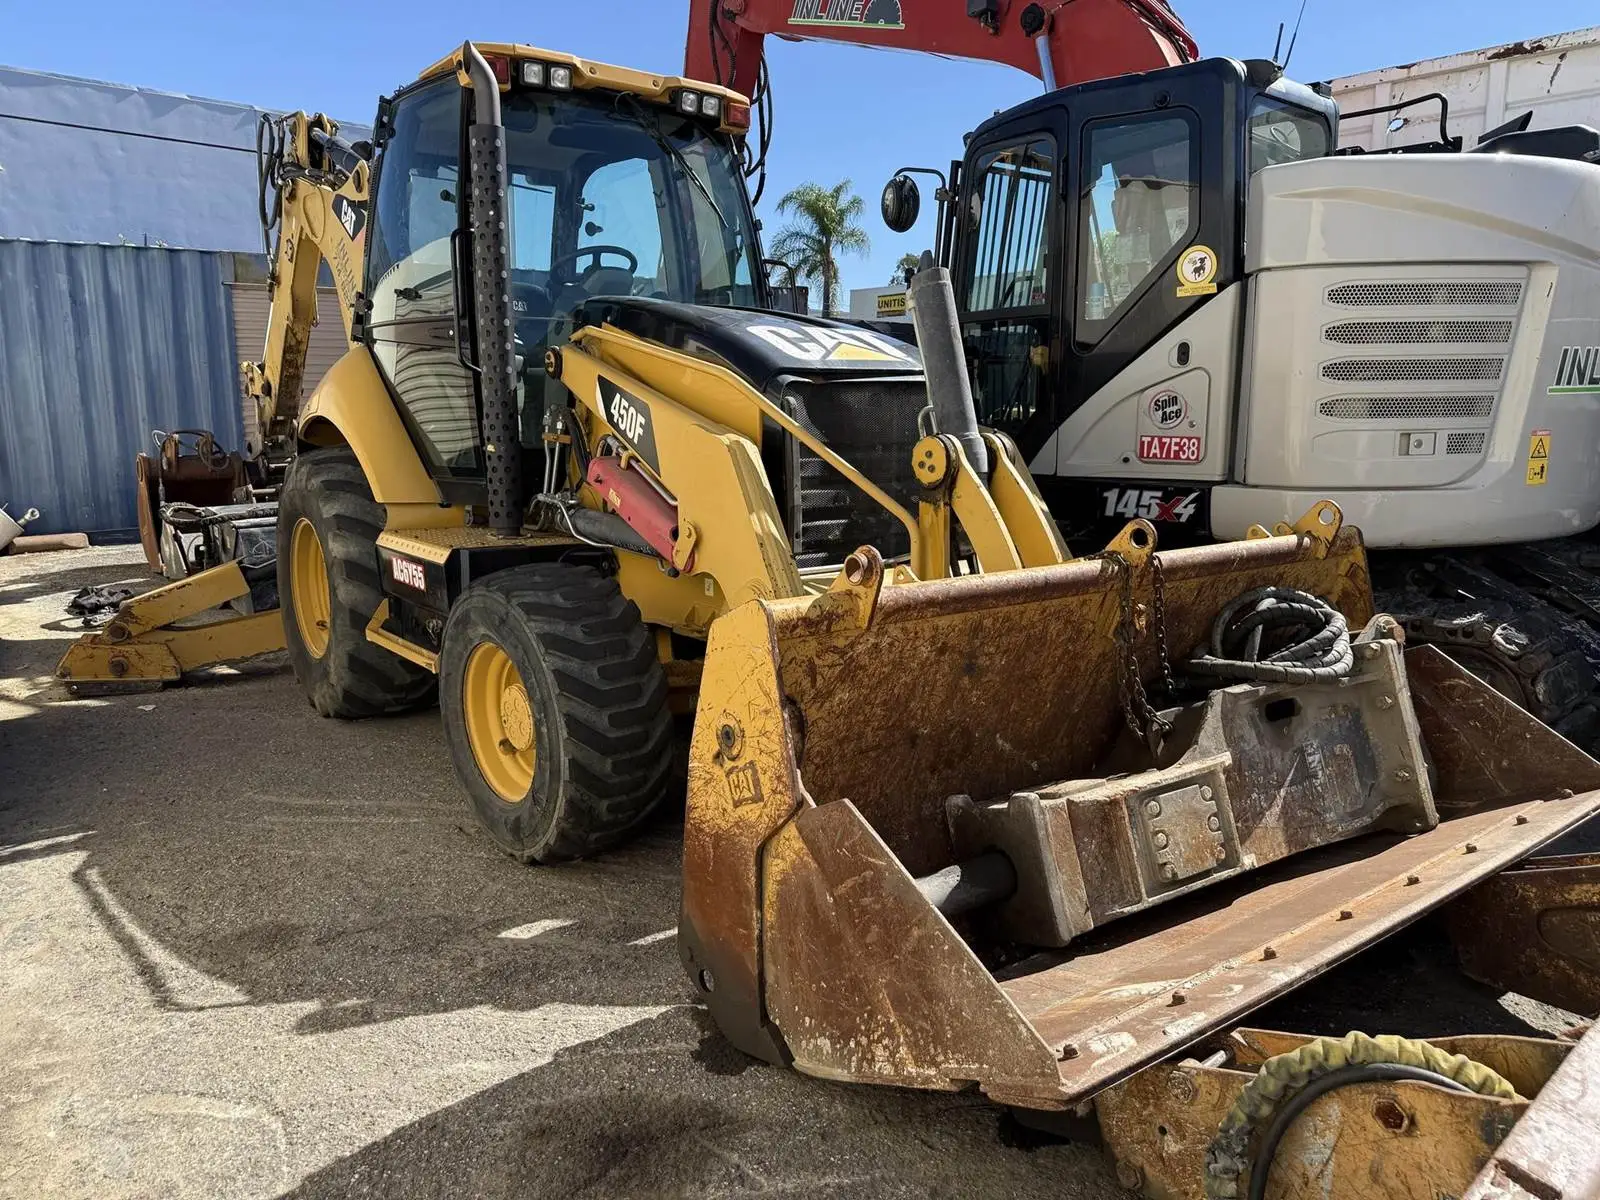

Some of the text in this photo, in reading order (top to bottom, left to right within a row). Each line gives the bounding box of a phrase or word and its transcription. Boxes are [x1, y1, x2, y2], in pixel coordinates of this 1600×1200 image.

[791, 0, 866, 22] INLINE
[341, 199, 357, 237] CAT
[746, 326, 921, 362] CAT
[1153, 395, 1178, 412] Spin
[610, 392, 646, 445] 450F
[1160, 408, 1182, 424] Ace
[1141, 436, 1199, 460] TA7F38
